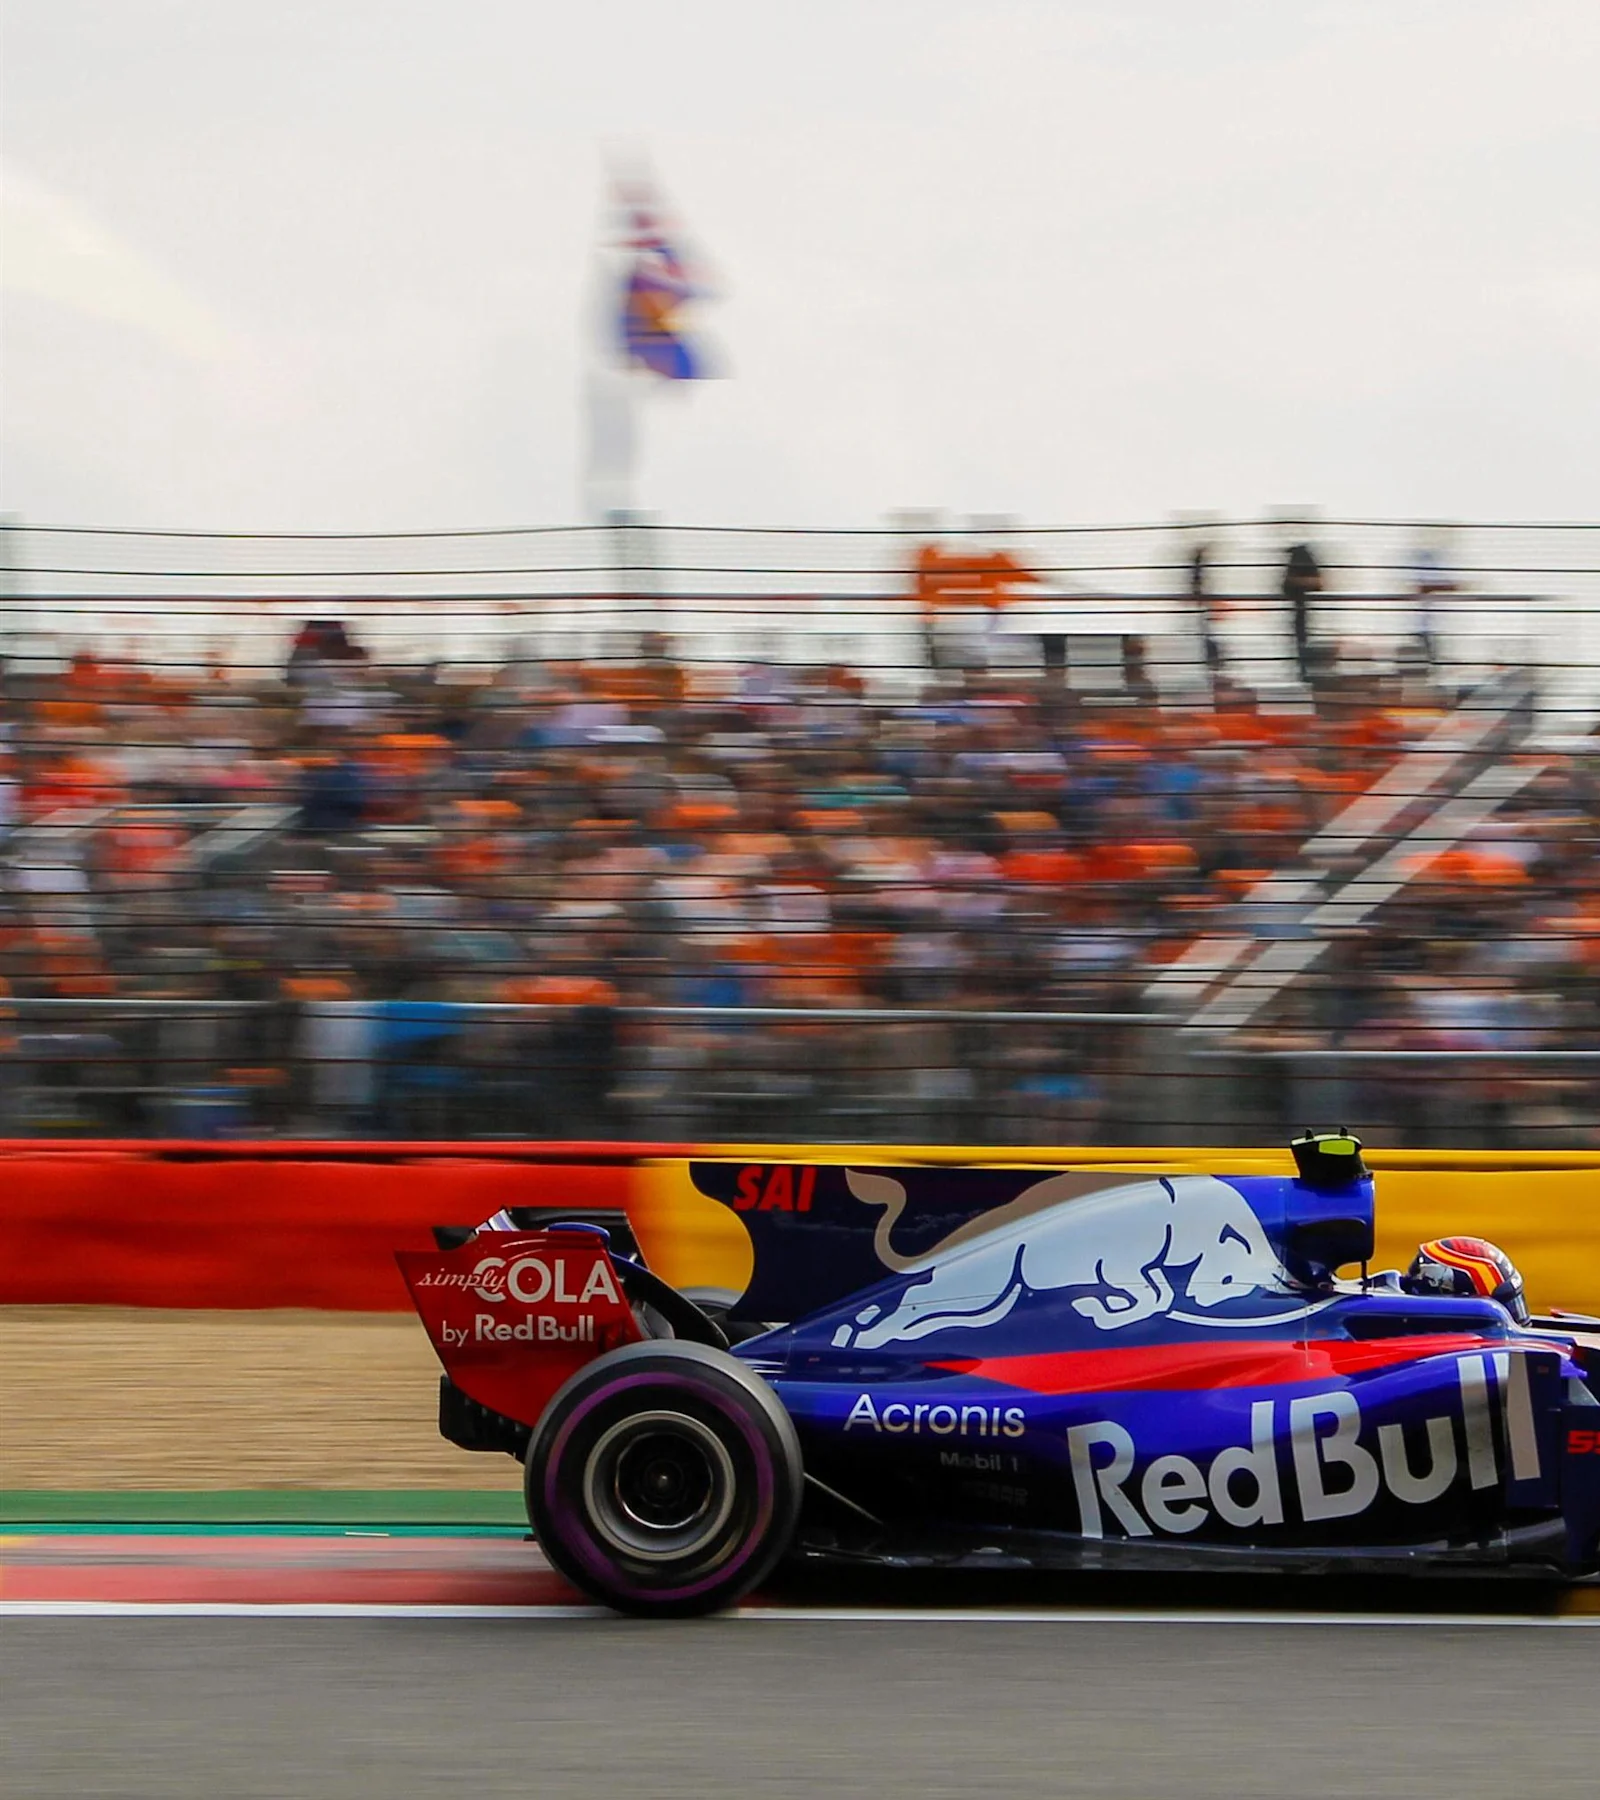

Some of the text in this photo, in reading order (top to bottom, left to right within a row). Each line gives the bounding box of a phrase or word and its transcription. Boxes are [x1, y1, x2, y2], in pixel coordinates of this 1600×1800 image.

[733, 1165, 816, 1212] SAI
[416, 1257, 619, 1304] simply COLA
[442, 1320, 468, 1347] by
[843, 1394, 1025, 1437] Acronis
[940, 1452, 1001, 1471] Mobil
